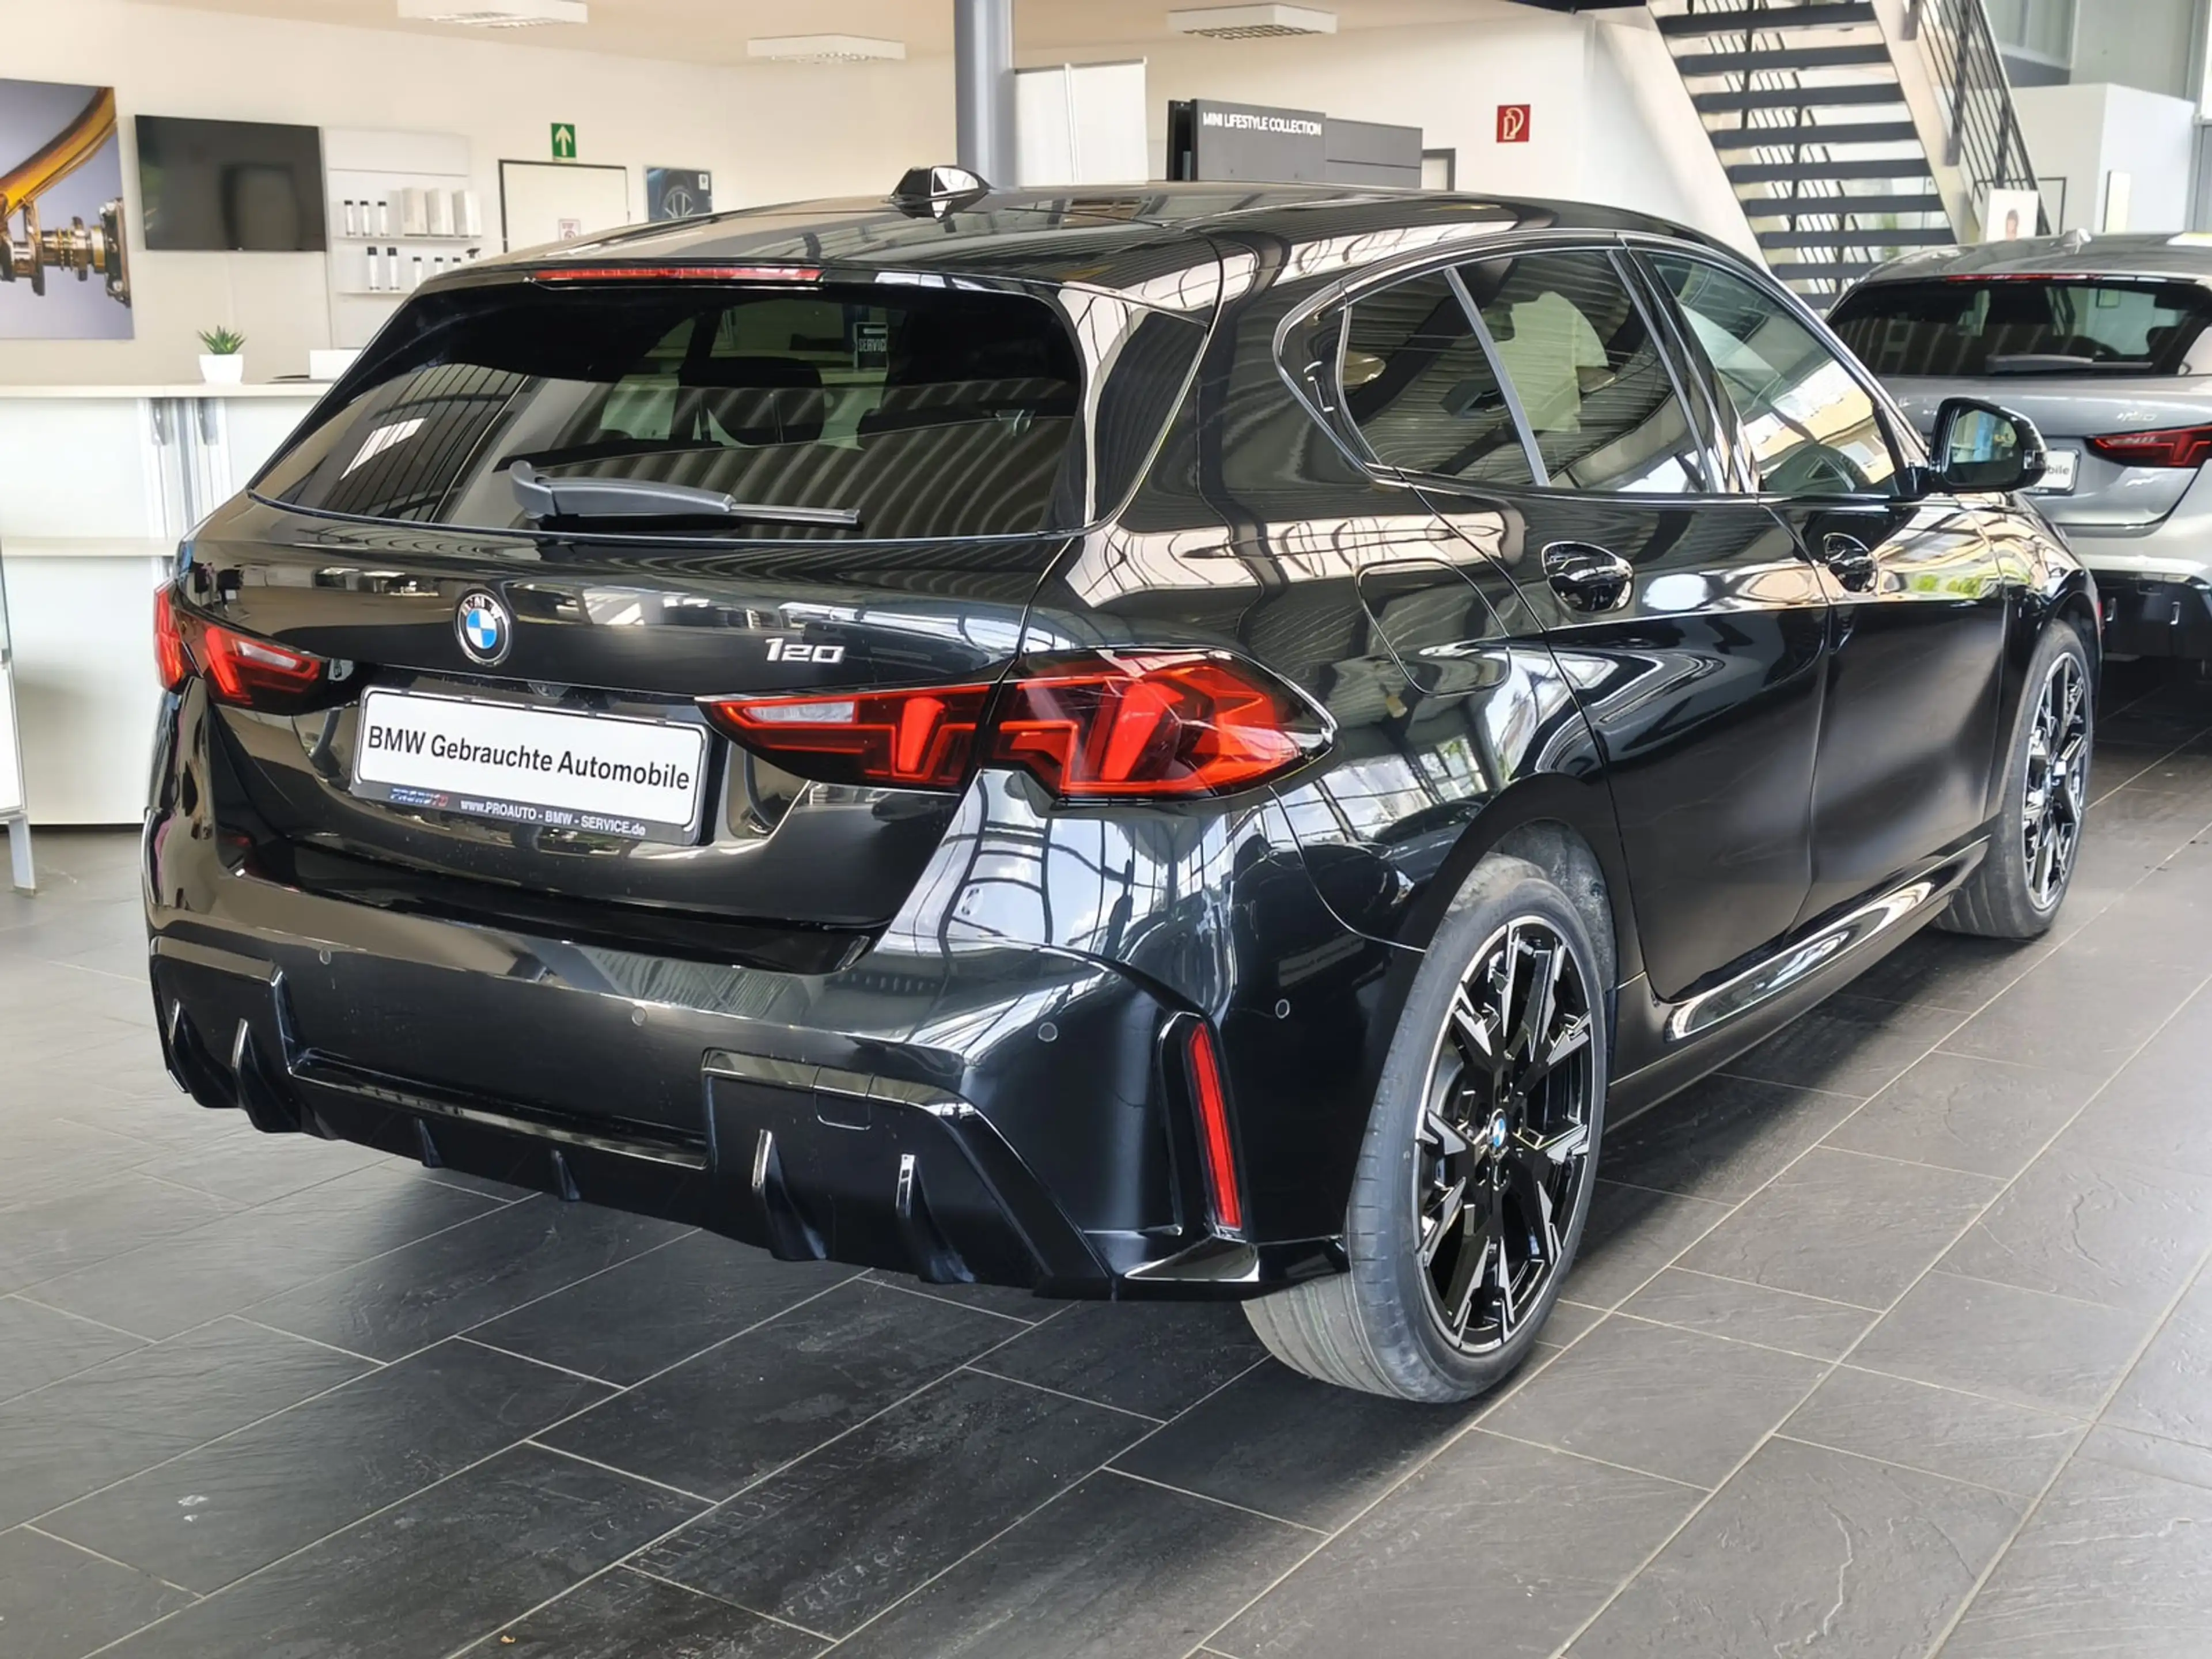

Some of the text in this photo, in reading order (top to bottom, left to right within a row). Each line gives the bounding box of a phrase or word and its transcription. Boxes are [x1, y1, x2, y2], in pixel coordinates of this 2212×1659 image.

[1203, 112, 1322, 137] MINI LIFESTYLE COLLECTION
[858, 338, 887, 352] SERVIC
[2046, 464, 2070, 475] bile
[461, 596, 503, 621] BMW
[765, 637, 845, 664] 120
[368, 725, 690, 790] BMW Gebrauchte Automobile
[544, 810, 573, 825] BMW
[581, 815, 646, 836] SERVICE.de
